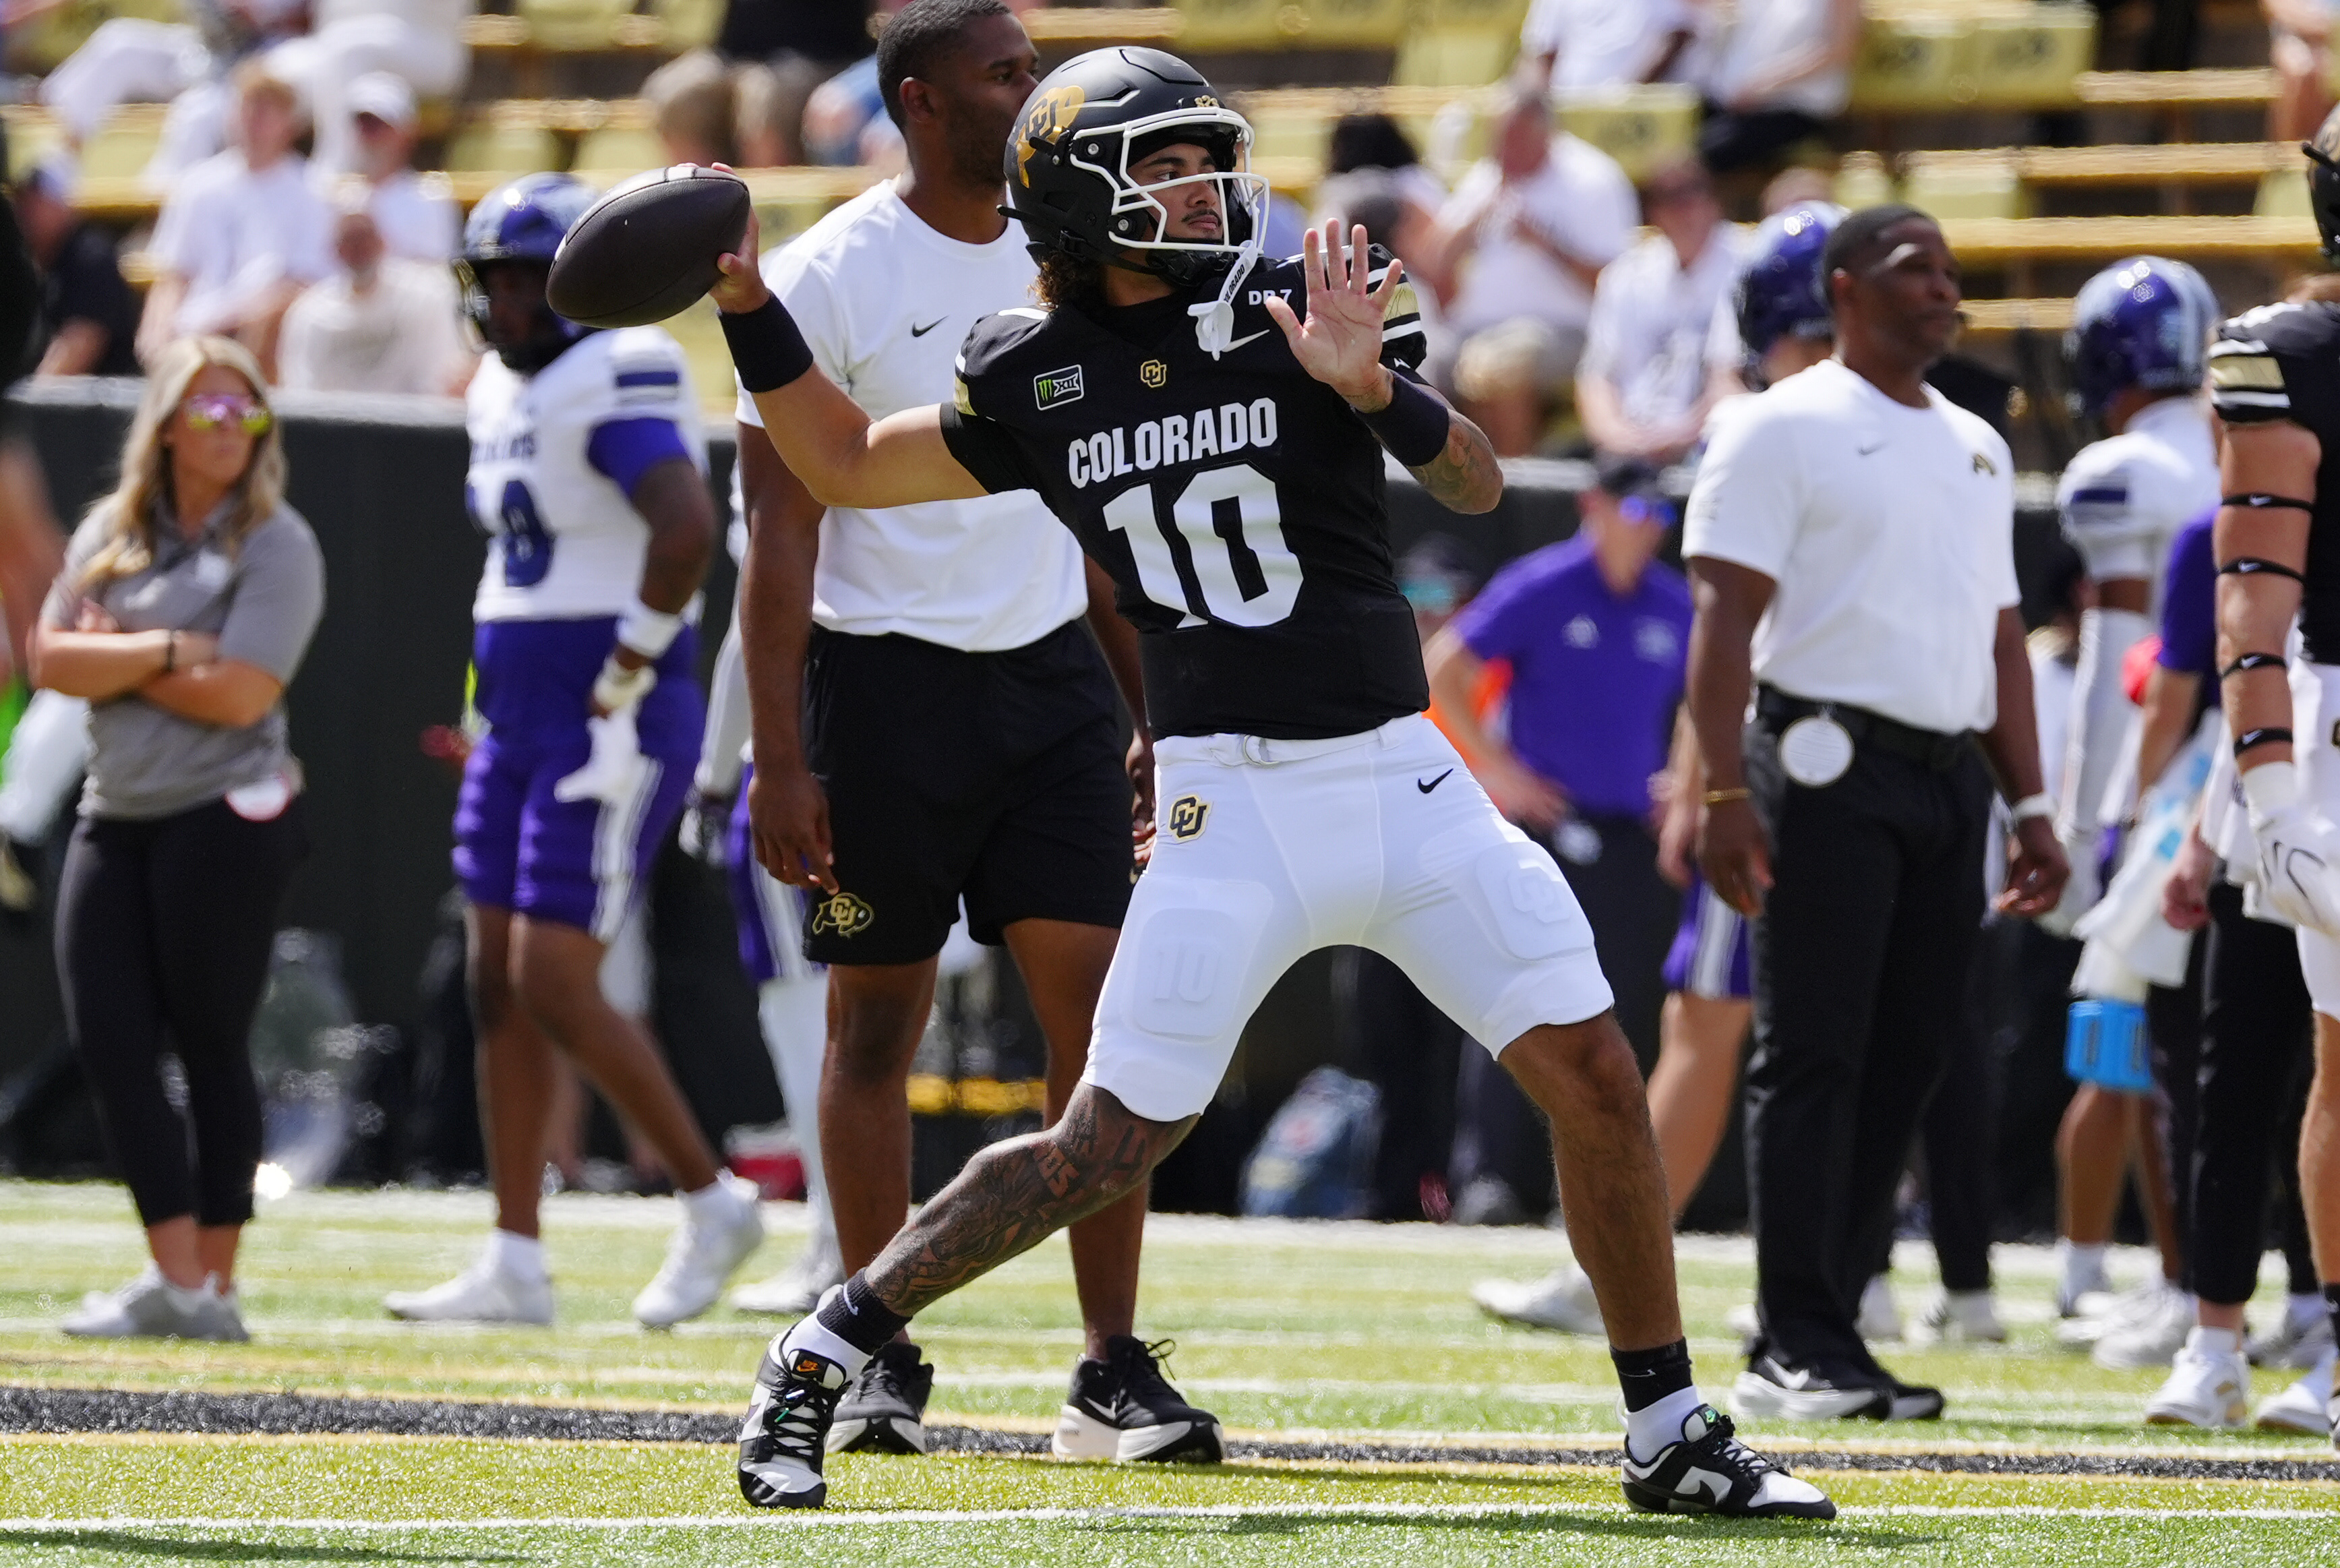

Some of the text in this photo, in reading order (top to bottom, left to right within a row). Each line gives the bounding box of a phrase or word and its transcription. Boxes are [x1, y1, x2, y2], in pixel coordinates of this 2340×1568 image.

[1140, 359, 1167, 388] CU
[1068, 397, 1278, 489] COLORADO
[1102, 463, 1304, 629] 10
[1169, 795, 1208, 839] CU
[830, 897, 857, 926] CU
